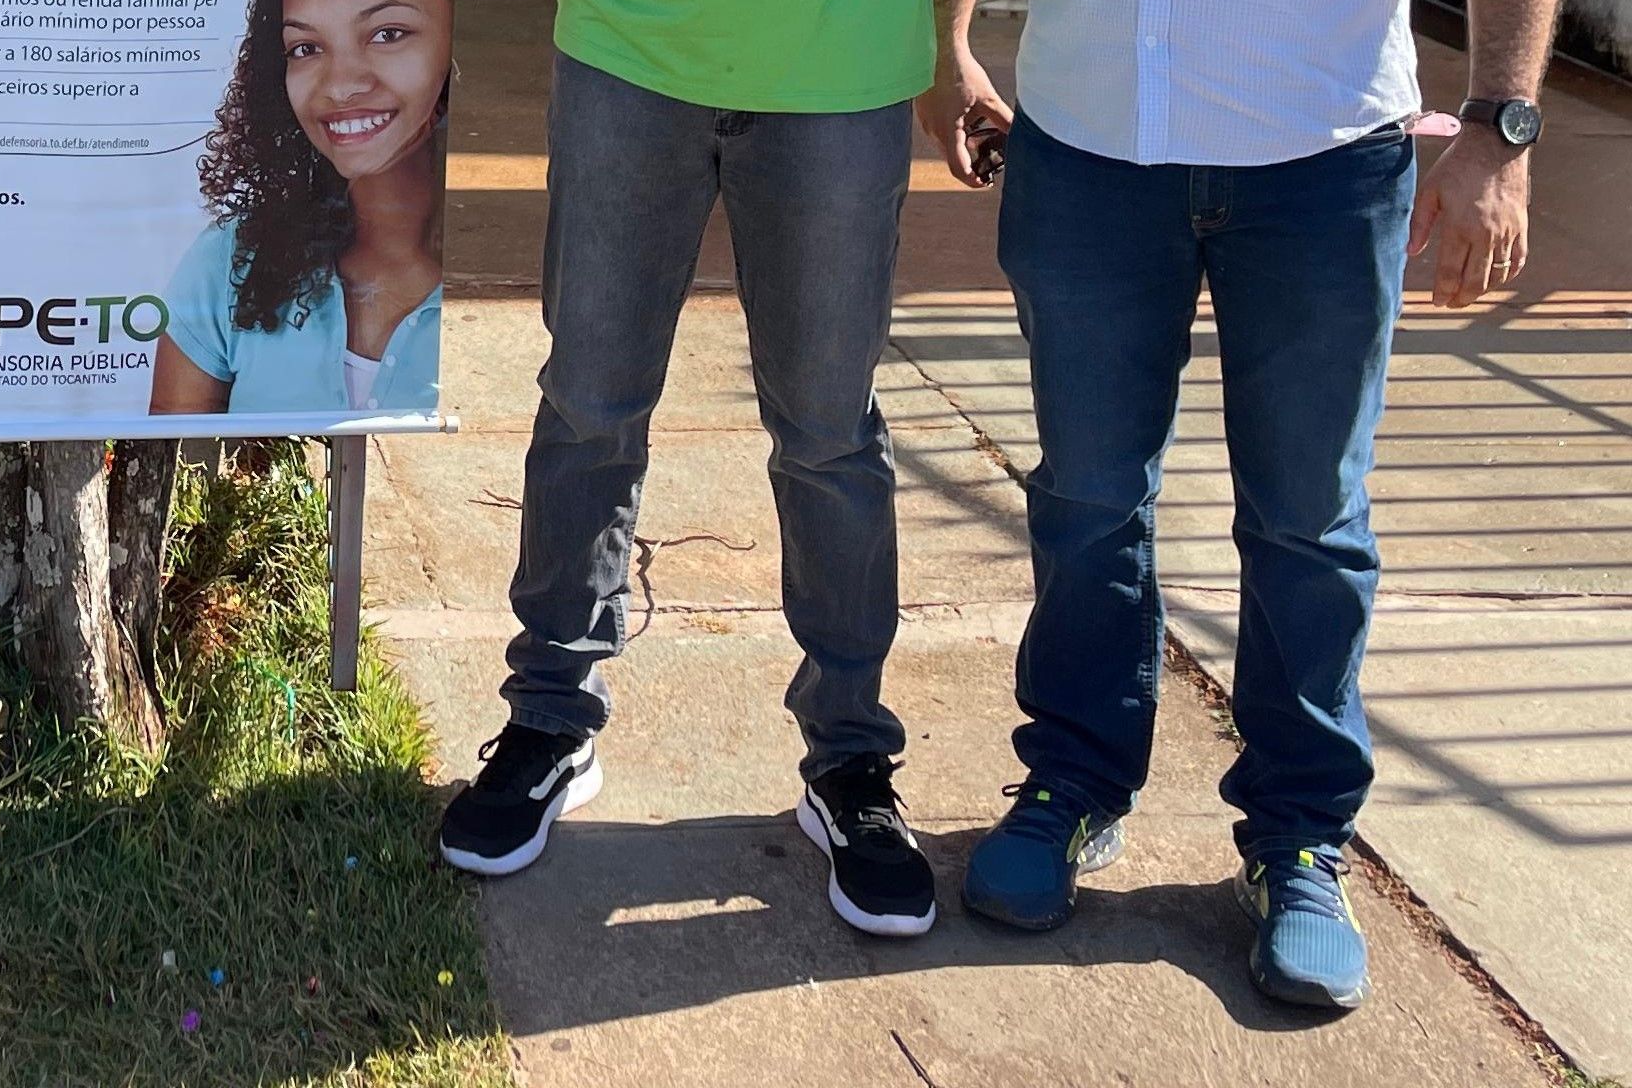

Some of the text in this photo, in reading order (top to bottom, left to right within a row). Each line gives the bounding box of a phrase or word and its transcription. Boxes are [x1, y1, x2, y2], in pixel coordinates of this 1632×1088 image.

[39, 12, 107, 30] mínimo
[113, 16, 143, 34] por
[147, 16, 206, 33] pessoa
[5, 50, 15, 61] a
[21, 45, 53, 62] 180
[57, 46, 122, 63] salários
[126, 46, 201, 63] mínimos
[52, 81, 126, 100] superior
[129, 84, 139, 96] a
[71, 351, 150, 372] PÚBLICA
[31, 375, 48, 386] DO
[53, 373, 117, 386] TOCANTINS
